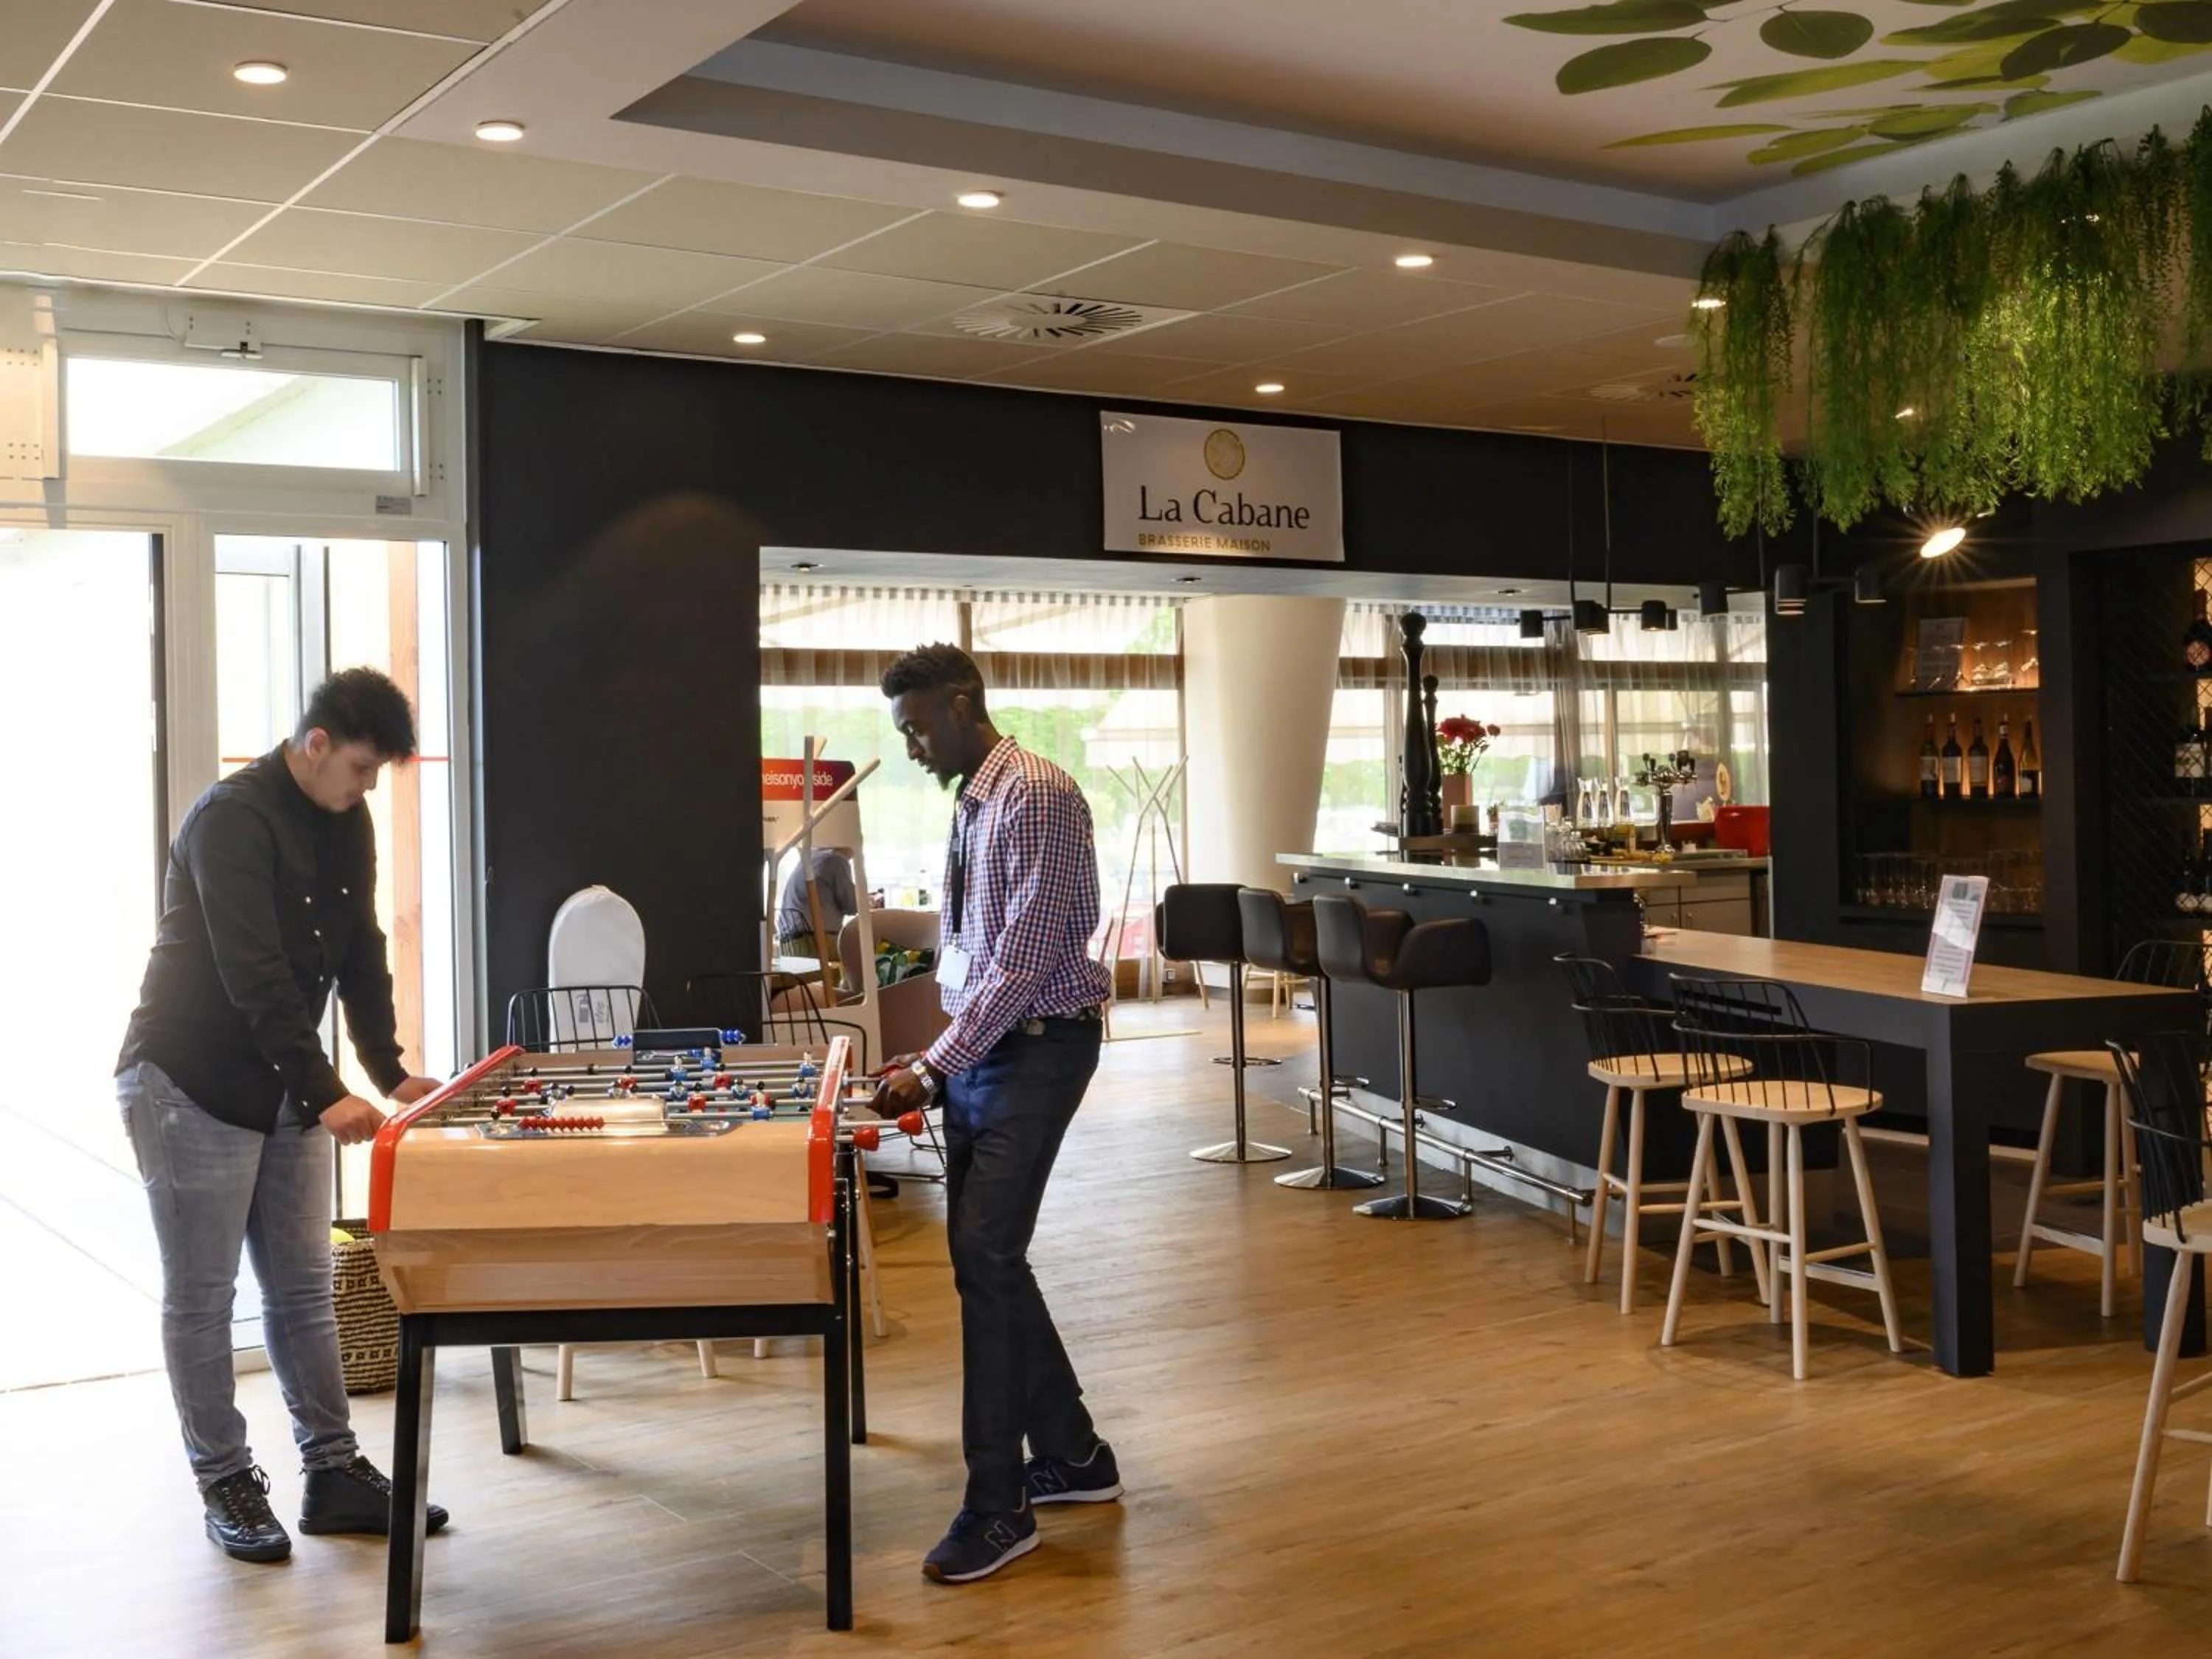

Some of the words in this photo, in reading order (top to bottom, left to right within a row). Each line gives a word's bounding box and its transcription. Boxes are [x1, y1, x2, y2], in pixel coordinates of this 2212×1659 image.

[1138, 485, 1182, 522] La
[1193, 490, 1310, 529] Cabane
[1138, 533, 1212, 549] BRASSERIE
[1217, 538, 1270, 552] MAISON
